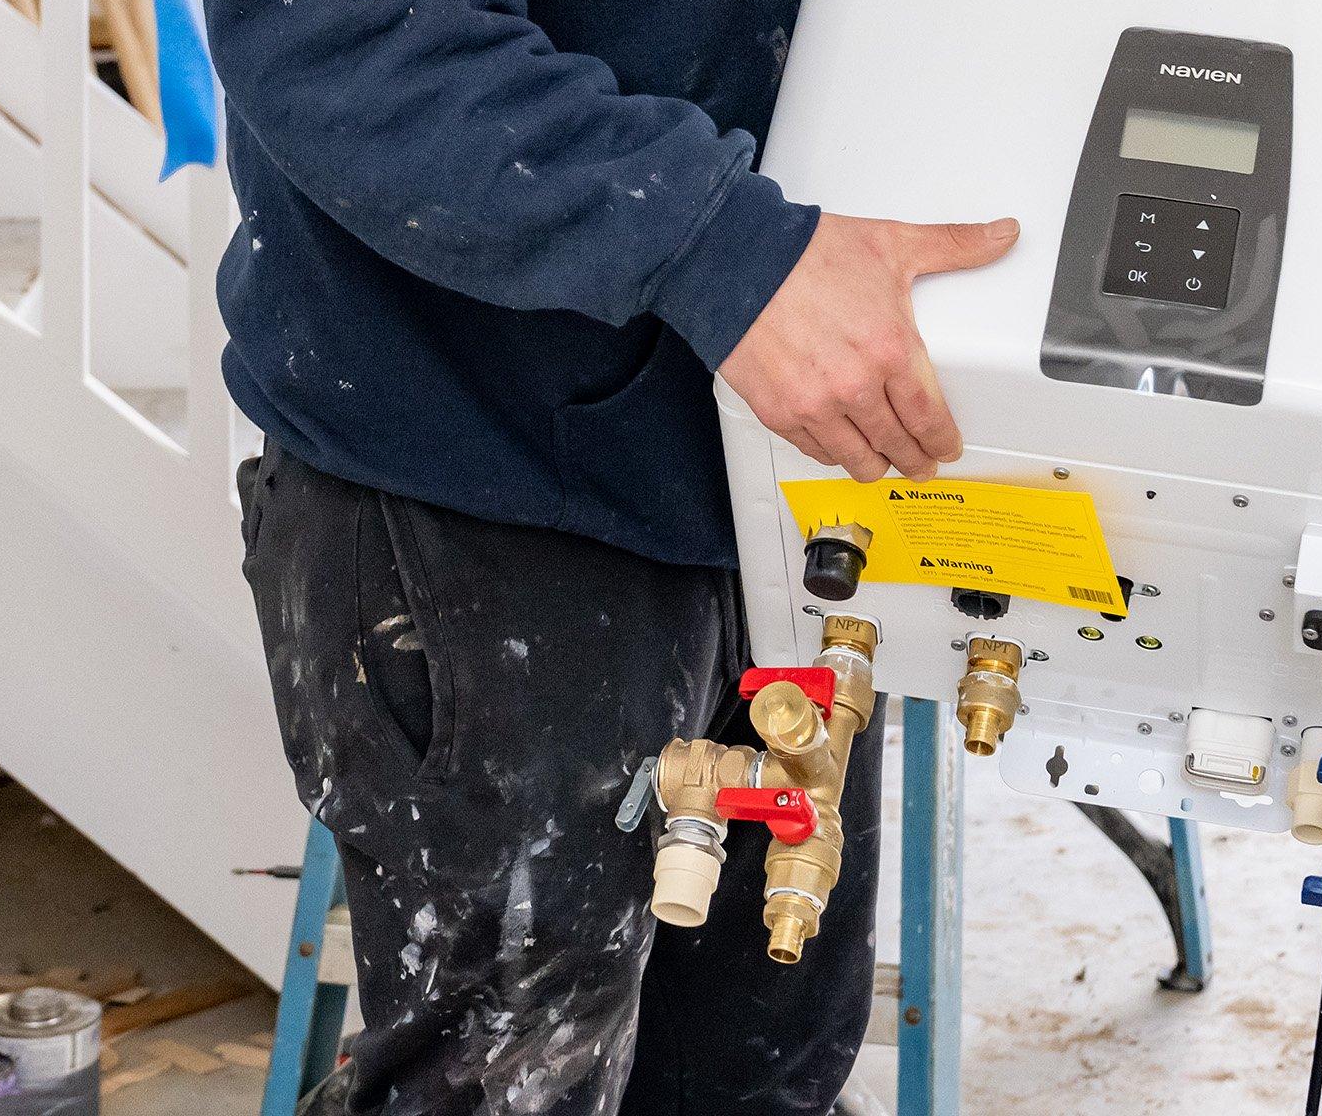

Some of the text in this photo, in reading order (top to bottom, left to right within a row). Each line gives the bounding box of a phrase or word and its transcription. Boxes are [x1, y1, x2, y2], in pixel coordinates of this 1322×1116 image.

[1127, 268, 1148, 284] OK
[905, 490, 965, 504] Warning
[936, 557, 994, 574] Warning
[835, 617, 865, 633] NPT
[982, 640, 1012, 654] NPT
